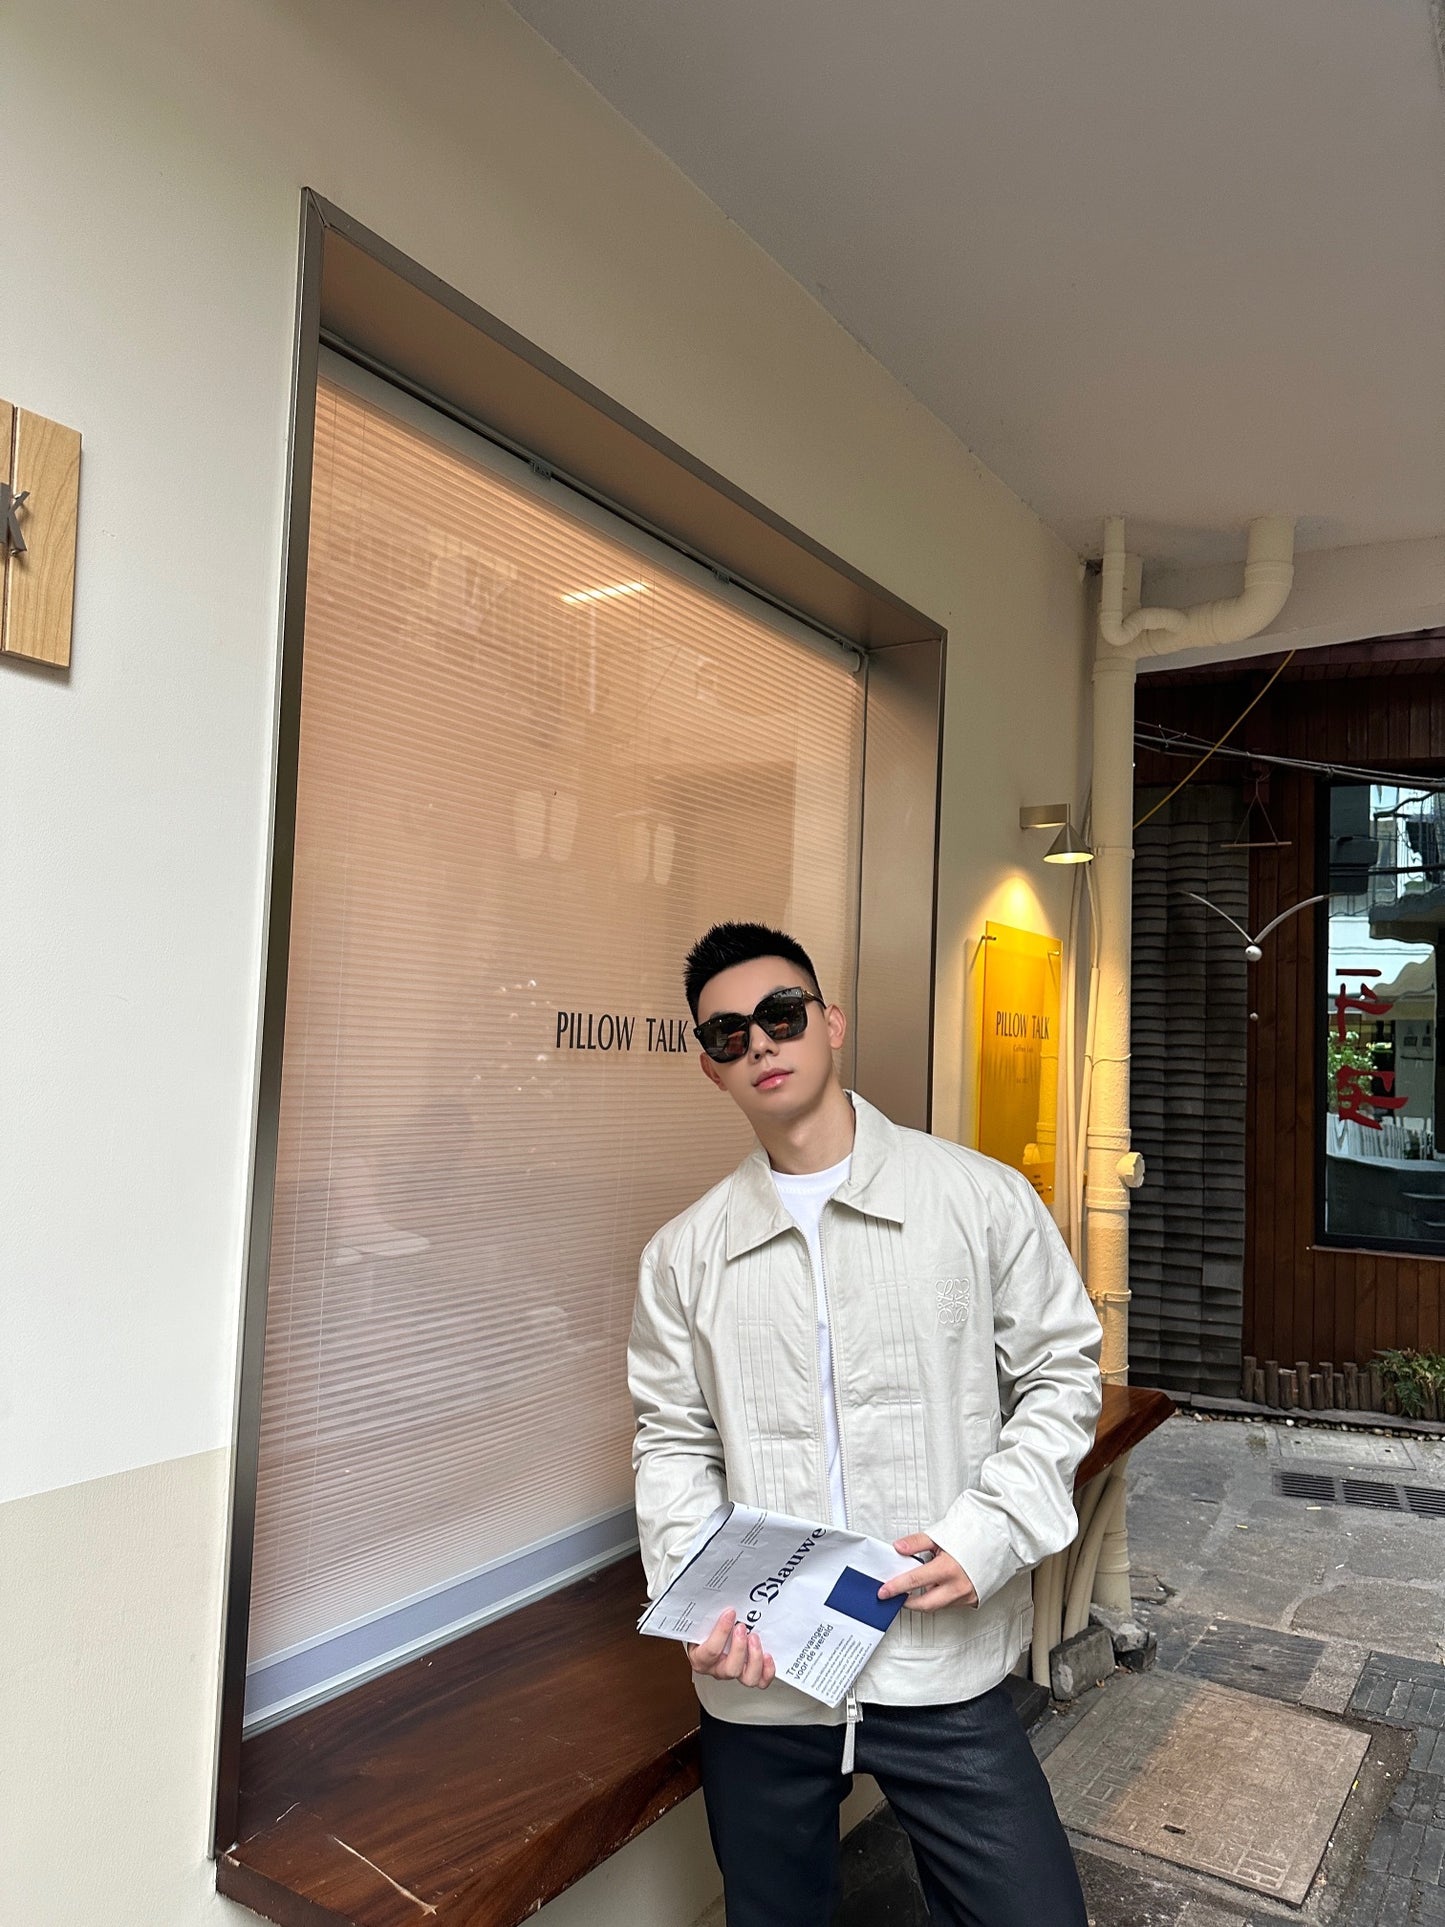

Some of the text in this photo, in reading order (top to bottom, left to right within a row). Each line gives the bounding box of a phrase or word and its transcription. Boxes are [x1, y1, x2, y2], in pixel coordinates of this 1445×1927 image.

[556, 1011, 688, 1053] PILLOW TALK
[996, 1010, 1050, 1040] PILLOW TALK
[749, 1528, 826, 1605] Blauwe
[786, 1624, 825, 1675] Tranenvanger
[794, 1661, 808, 1680] voor
[806, 1651, 816, 1662] de
[813, 1624, 834, 1650] wereld
